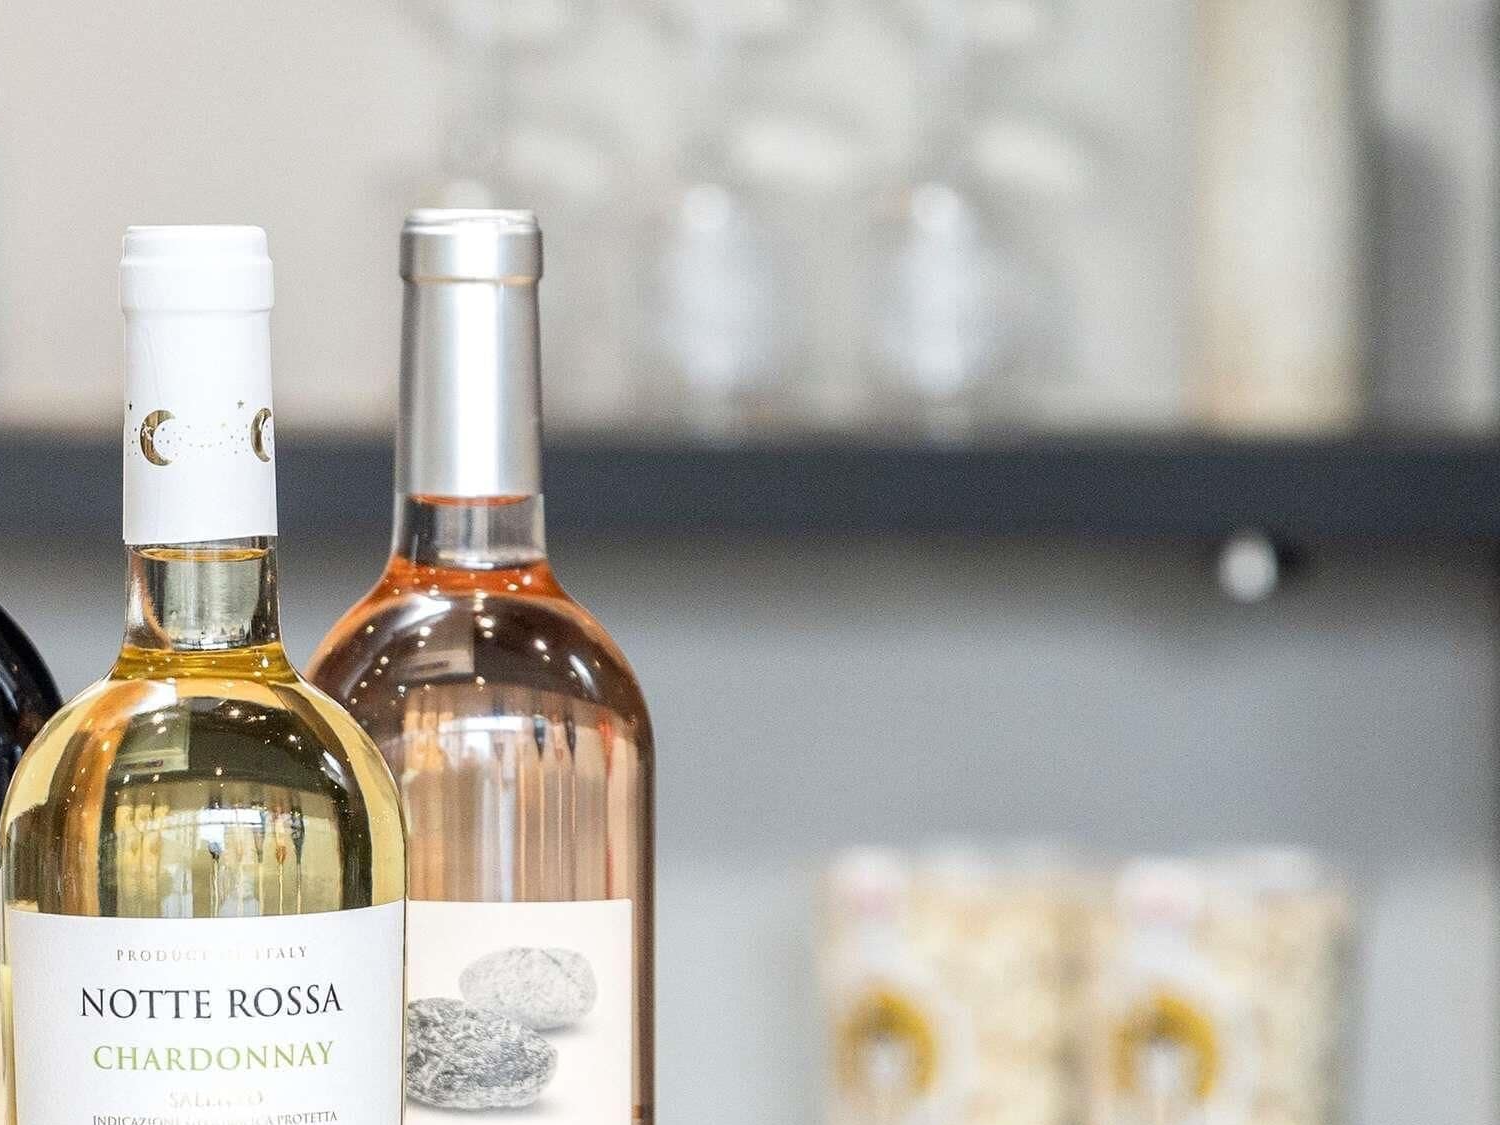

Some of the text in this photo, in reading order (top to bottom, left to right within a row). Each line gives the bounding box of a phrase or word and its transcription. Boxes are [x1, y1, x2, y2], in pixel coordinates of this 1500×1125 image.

[80, 982, 344, 1019] NOTTE ROSSA
[93, 1040, 335, 1072] CHARDONNAY
